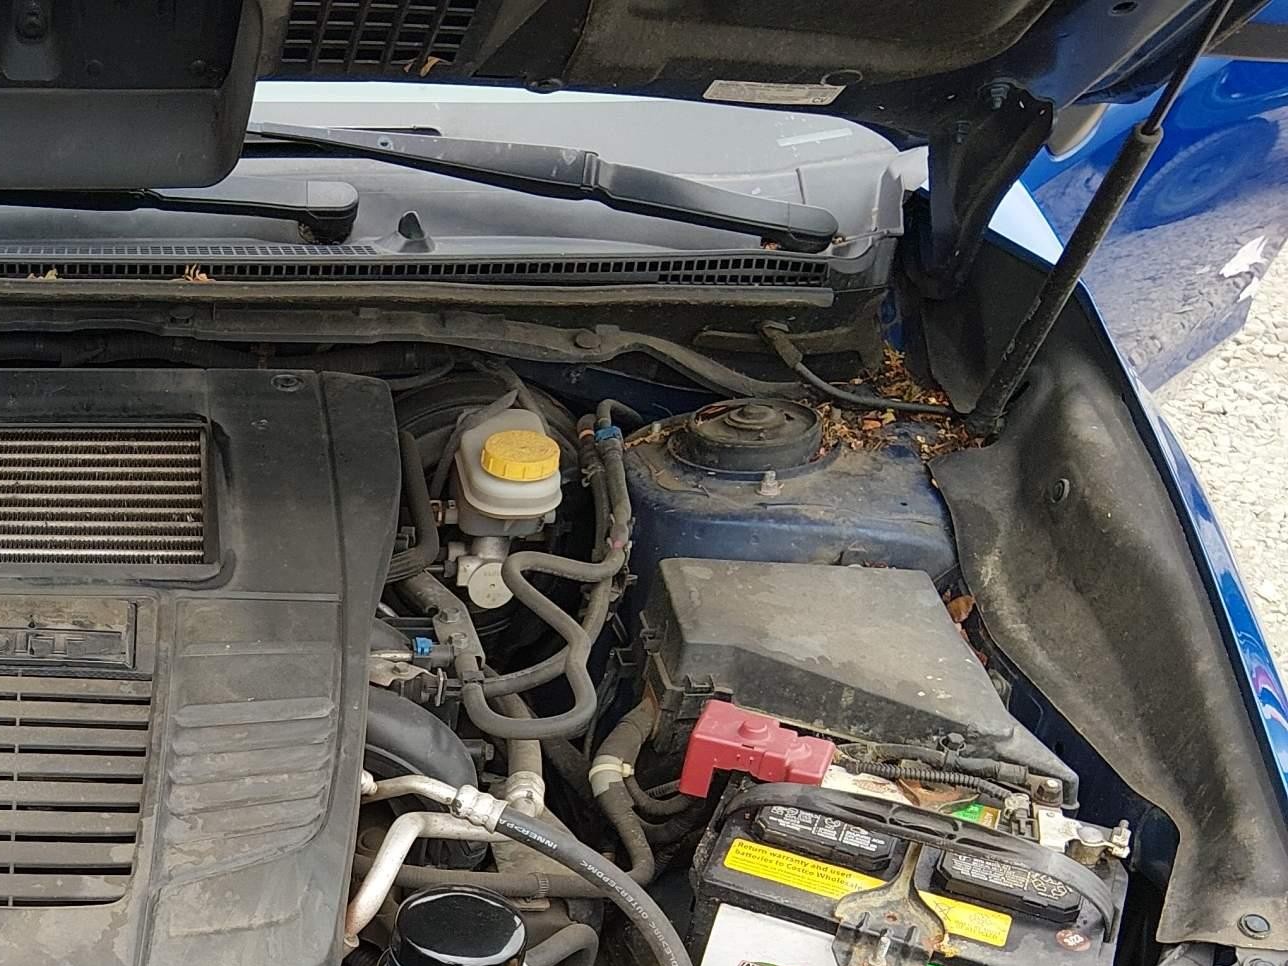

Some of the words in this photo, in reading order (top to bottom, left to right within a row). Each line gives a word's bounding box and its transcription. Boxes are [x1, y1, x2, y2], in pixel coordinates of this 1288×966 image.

[735, 848, 774, 865] batteries
[775, 859, 785, 868] to
[786, 863, 815, 877] Costco
[737, 841, 768, 856] Return
[769, 851, 810, 868] warranty
[811, 862, 829, 873] and
[830, 868, 853, 879] used
